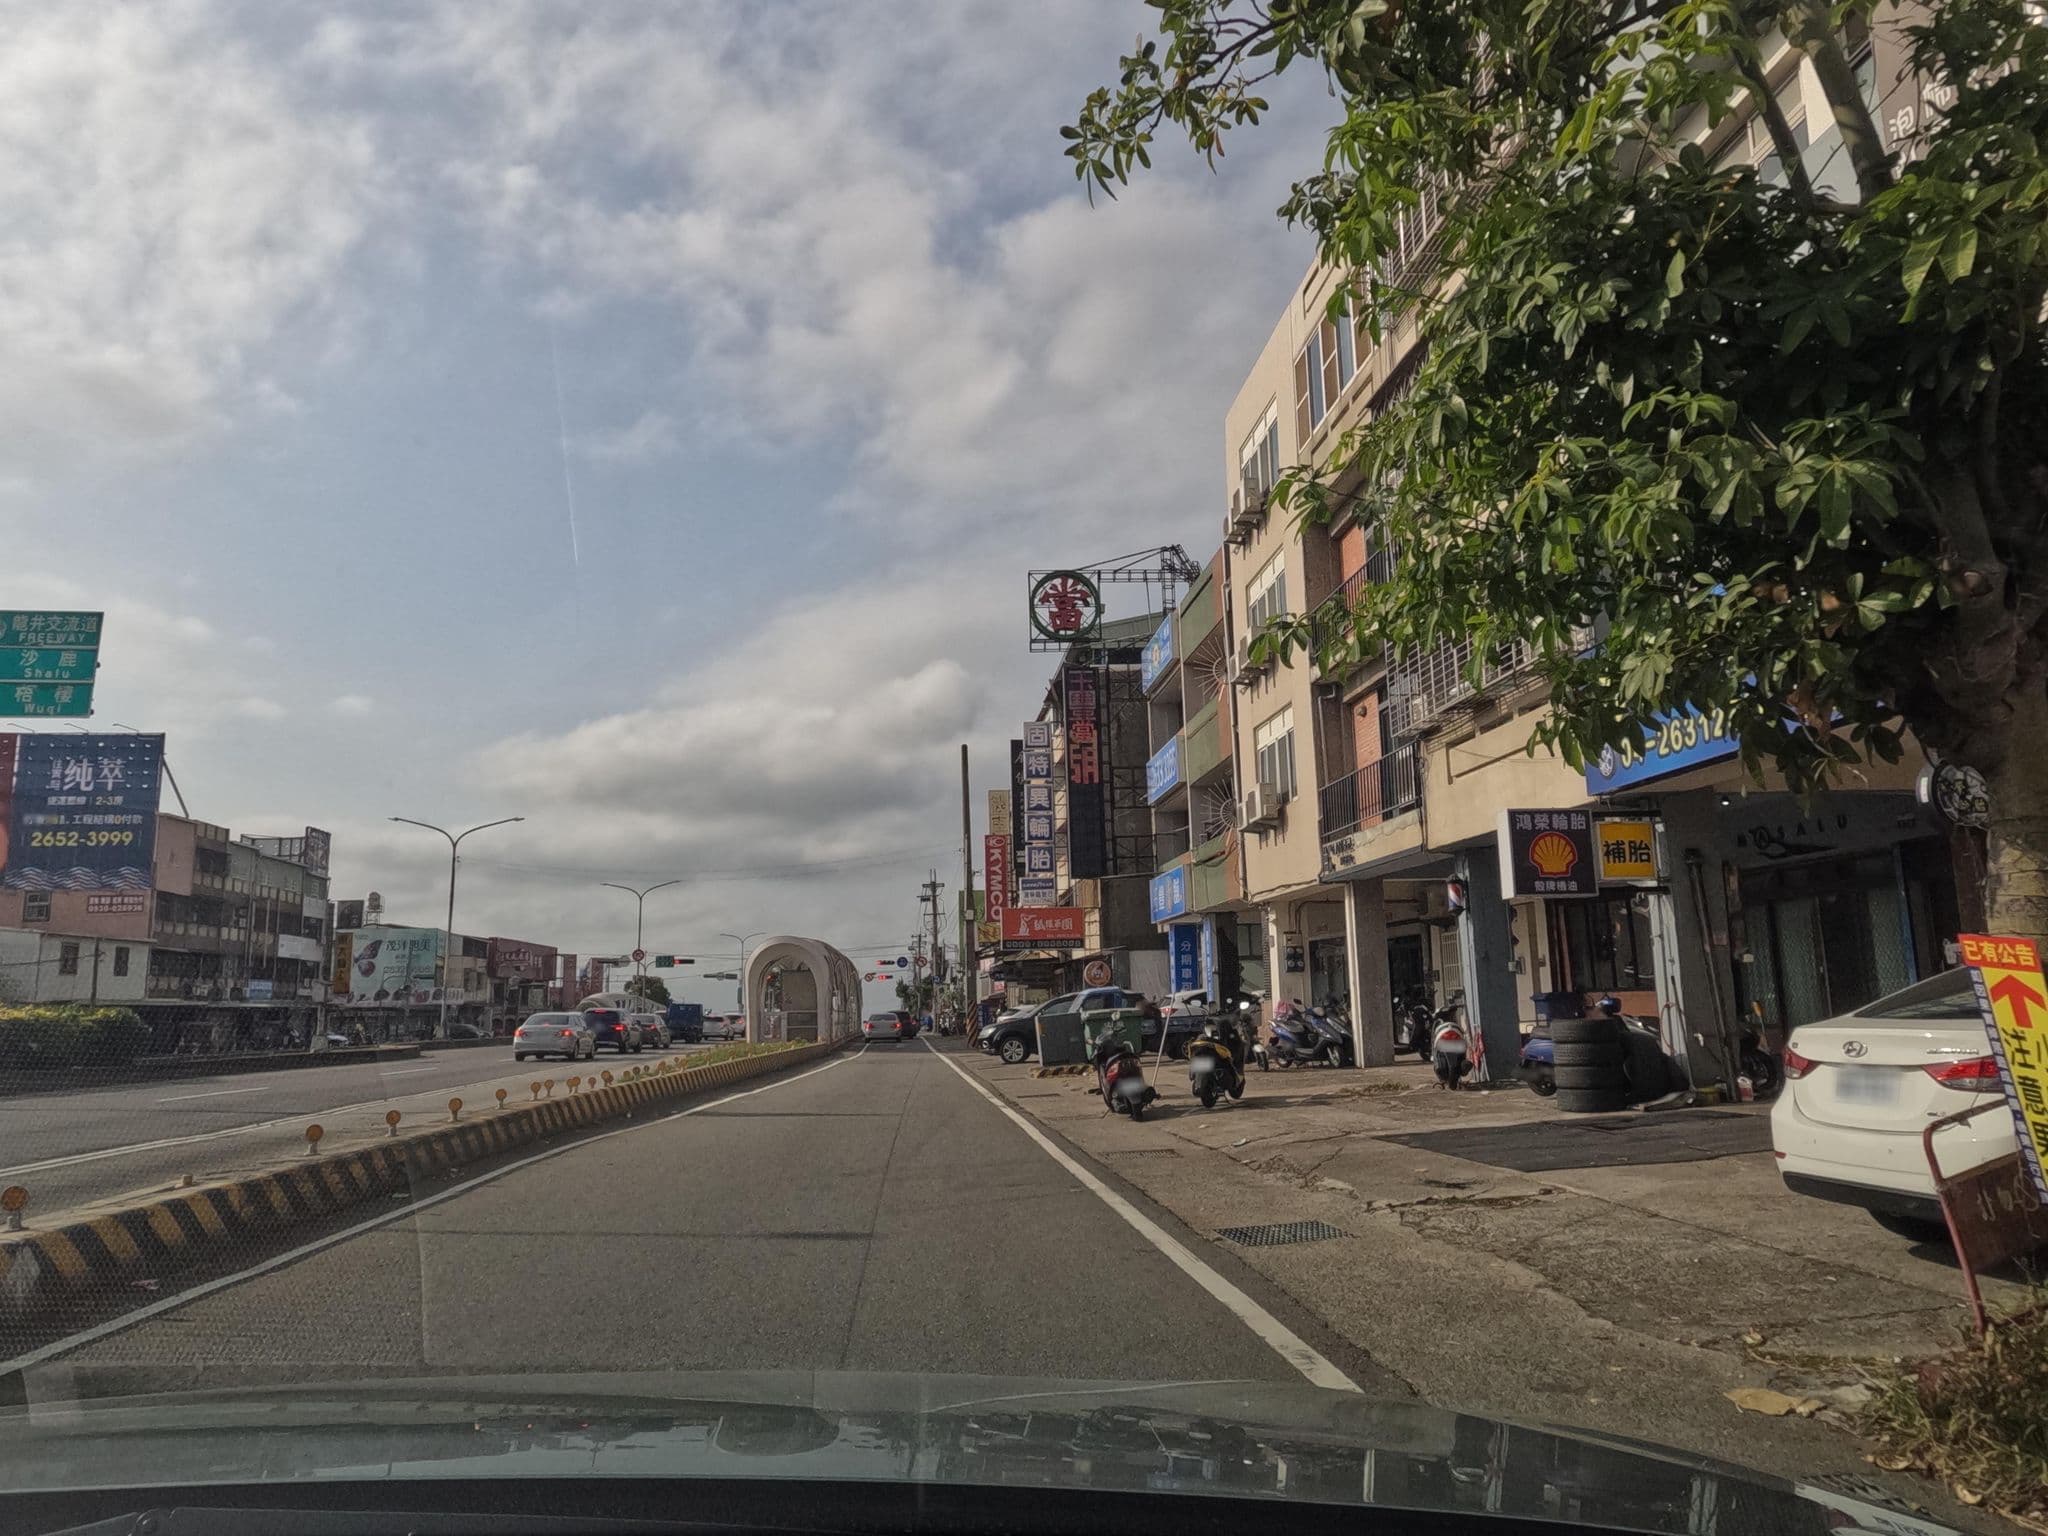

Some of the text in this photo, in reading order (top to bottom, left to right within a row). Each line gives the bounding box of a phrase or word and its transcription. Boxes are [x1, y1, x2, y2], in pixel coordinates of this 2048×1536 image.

[1039, 576, 1090, 632] 當
[13, 615, 97, 632] 龍井交流道
[18, 633, 86, 642] FREEWAY
[24, 668, 71, 678] Shalu
[24, 704, 62, 714] Wuqi
[1027, 727, 1051, 870] 固特異輪胎
[1516, 814, 1586, 830] 鴻榮輪胎
[31, 831, 133, 847] 2652-3999
[1603, 840, 1650, 864] 補胎
[990, 848, 1003, 920] KYMCO
[1963, 940, 2035, 967] 已有公告
